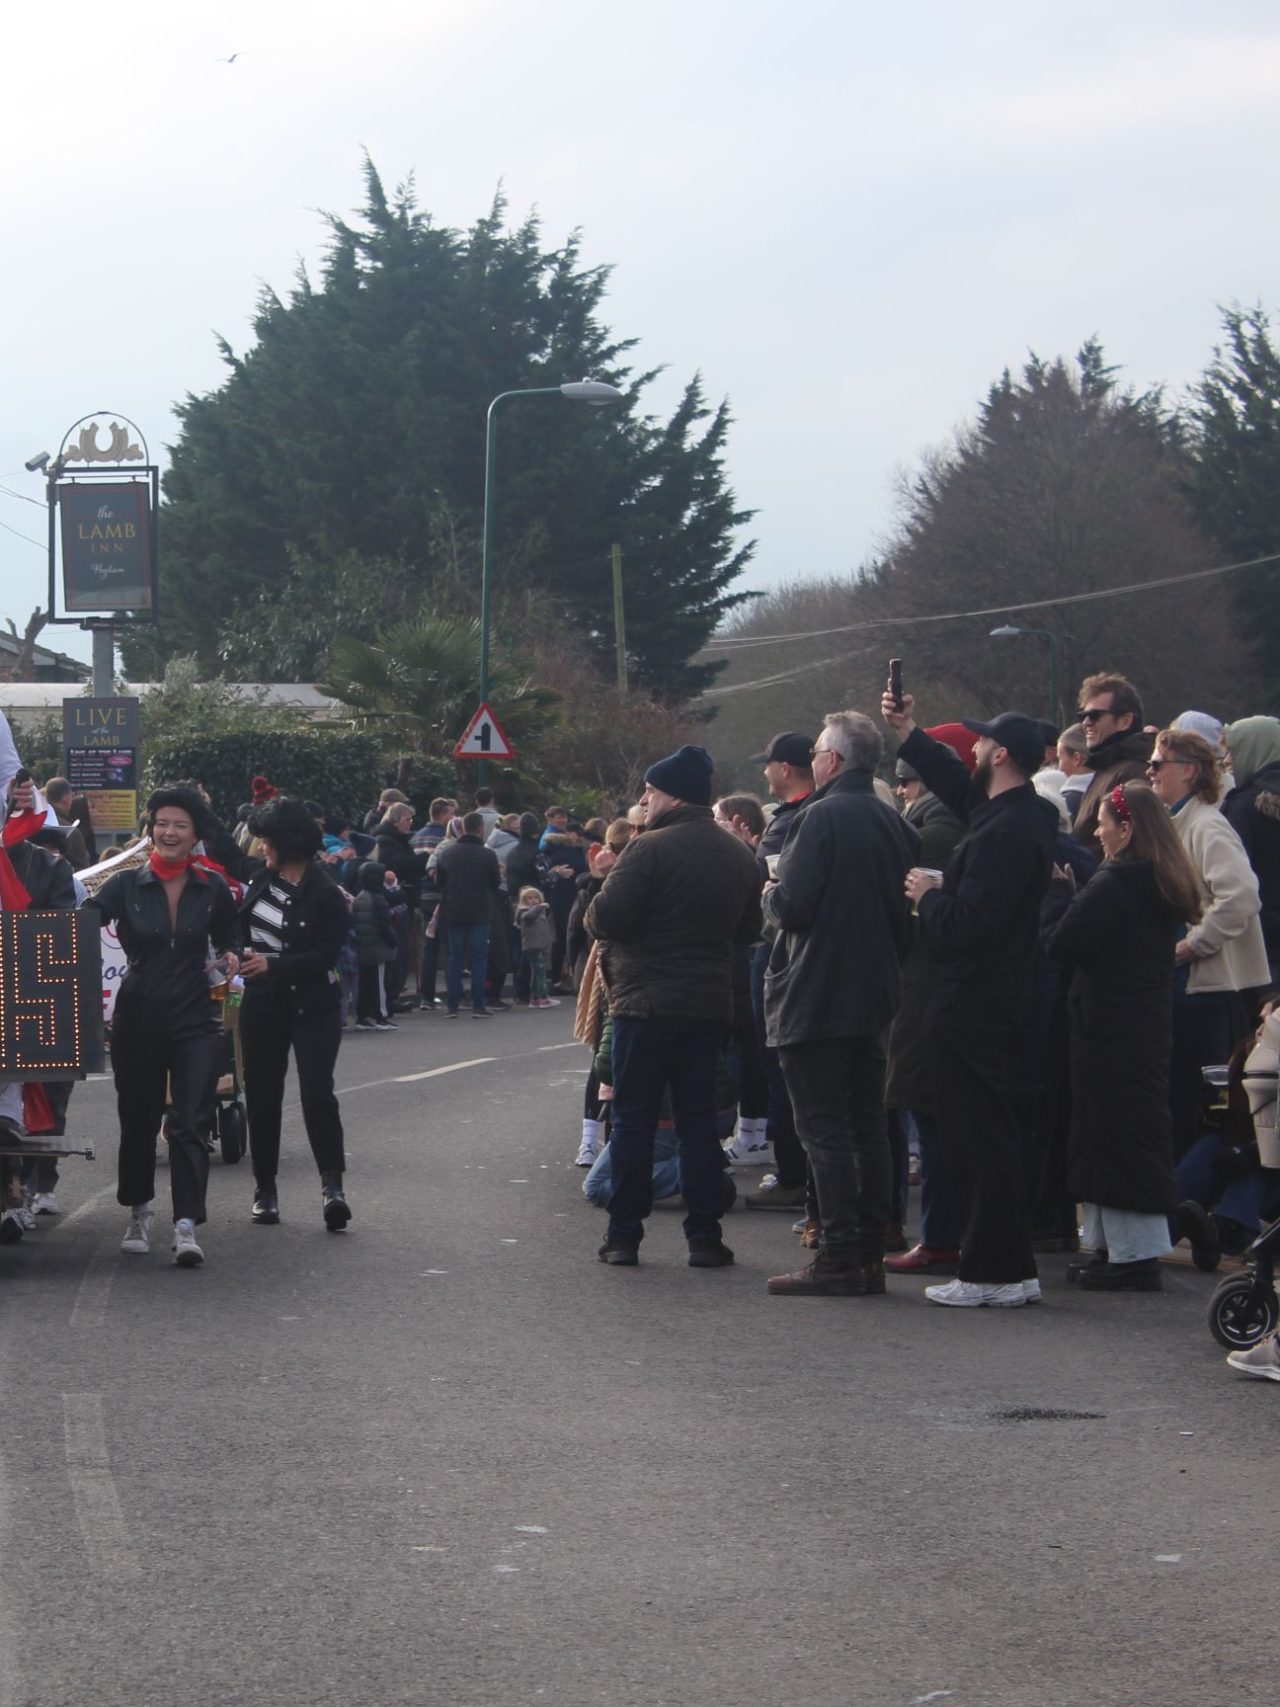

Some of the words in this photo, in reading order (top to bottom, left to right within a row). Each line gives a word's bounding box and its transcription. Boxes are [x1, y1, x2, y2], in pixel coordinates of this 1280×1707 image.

[96, 504, 114, 519] the
[79, 523, 136, 540] LAMB
[90, 543, 125, 554] INN
[76, 708, 127, 726] LIVE
[83, 735, 121, 747] LAMB
